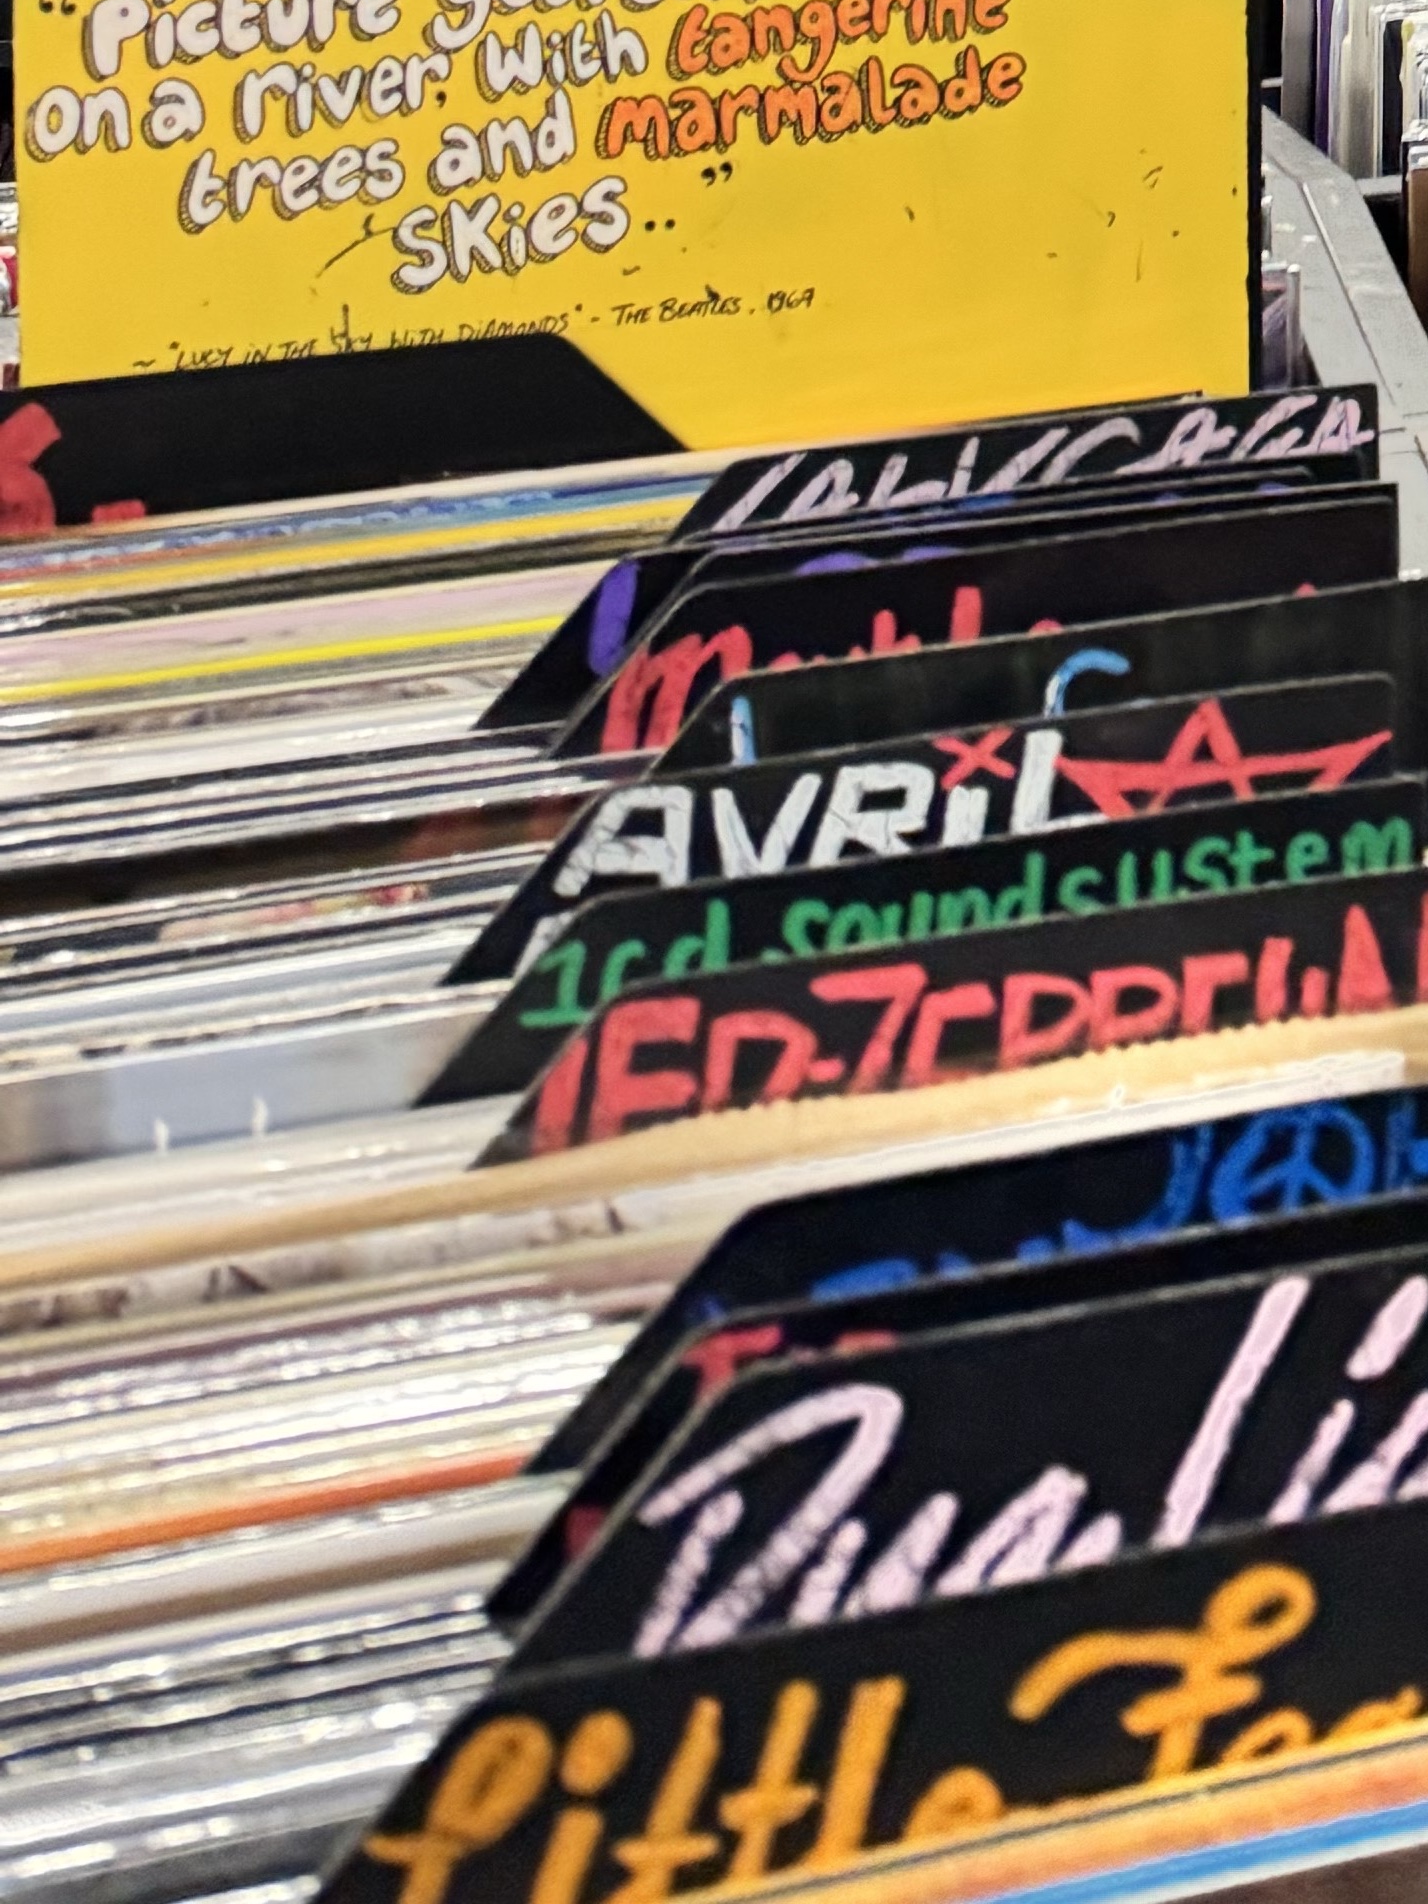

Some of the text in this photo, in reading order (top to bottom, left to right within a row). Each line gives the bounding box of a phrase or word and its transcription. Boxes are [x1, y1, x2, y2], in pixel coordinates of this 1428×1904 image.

[145, 77, 202, 148] a
[178, 44, 1025, 235] trees and marmalade
[612, 301, 650, 327] THE
